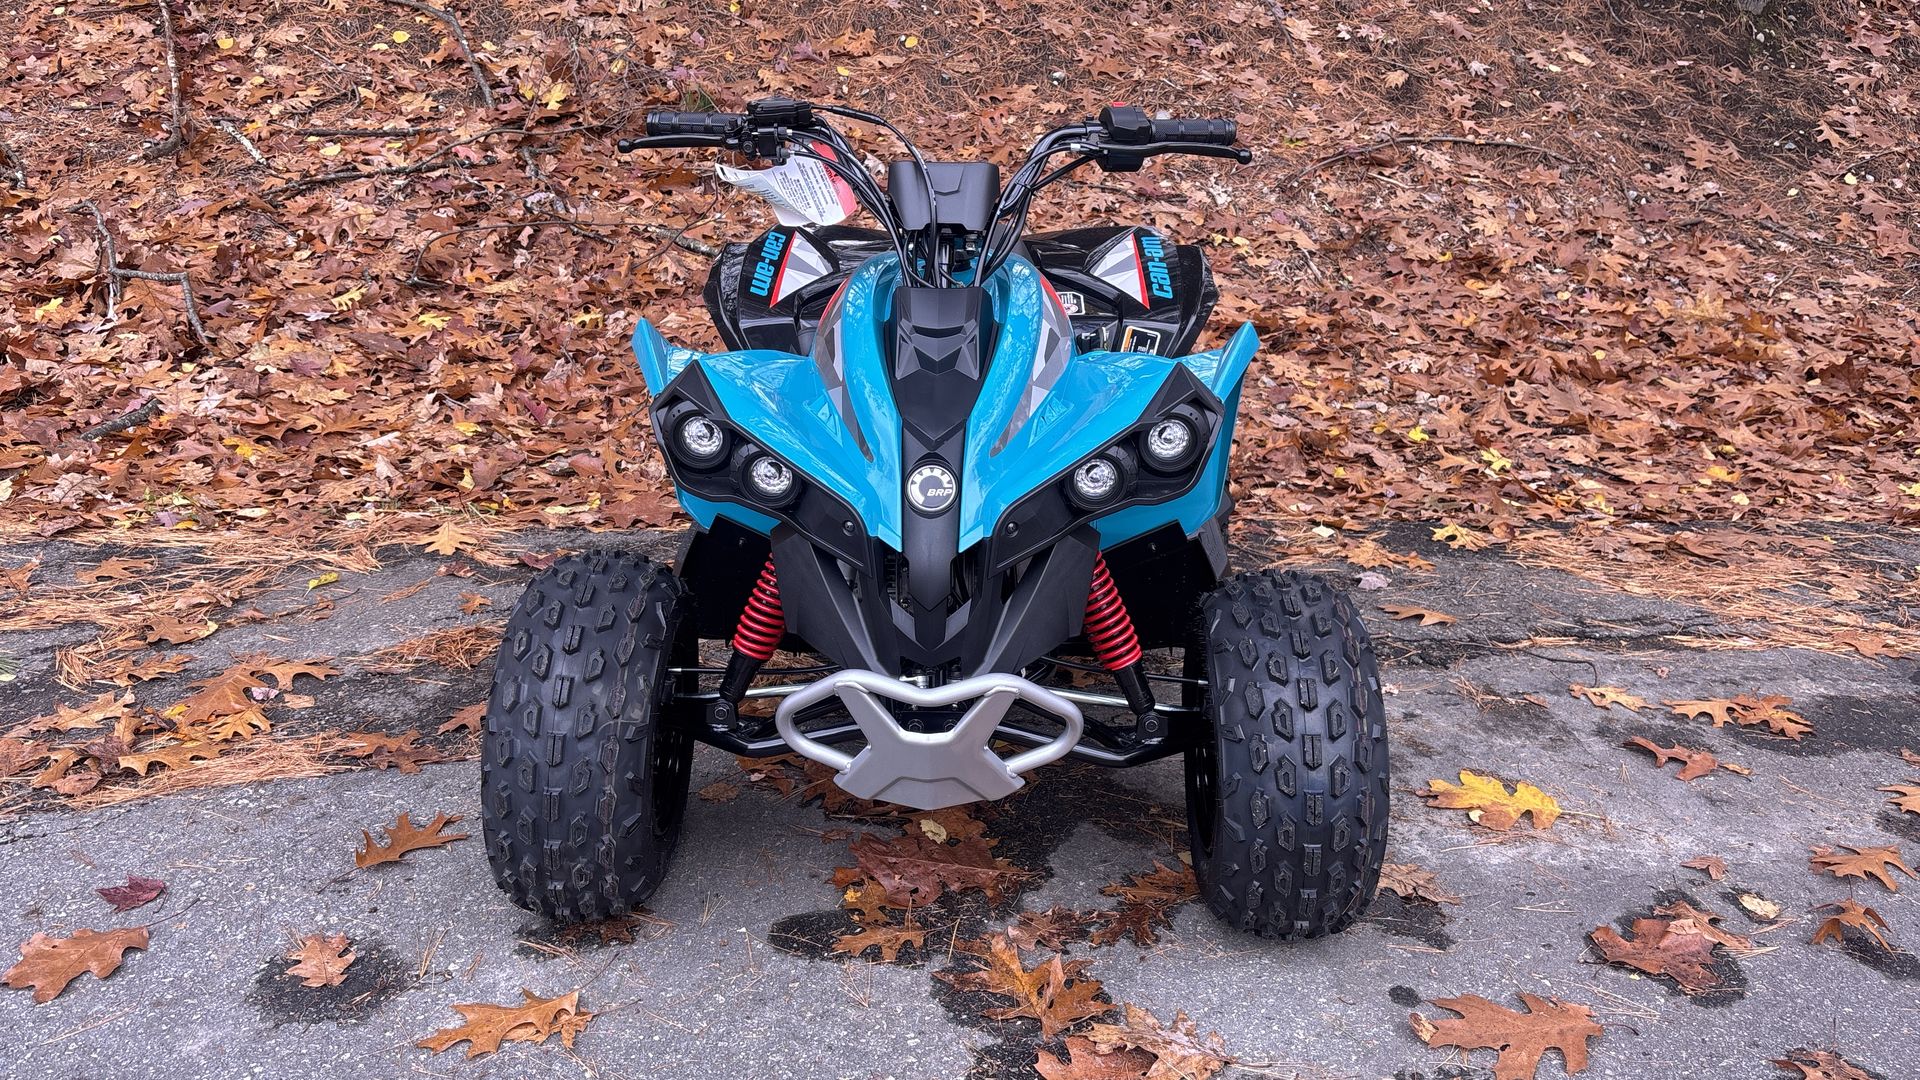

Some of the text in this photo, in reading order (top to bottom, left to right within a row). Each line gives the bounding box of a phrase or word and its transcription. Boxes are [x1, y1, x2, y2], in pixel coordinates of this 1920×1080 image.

[749, 231, 786, 297] can-am
[1140, 236, 1173, 300] can-am
[926, 488, 953, 497] BRP
